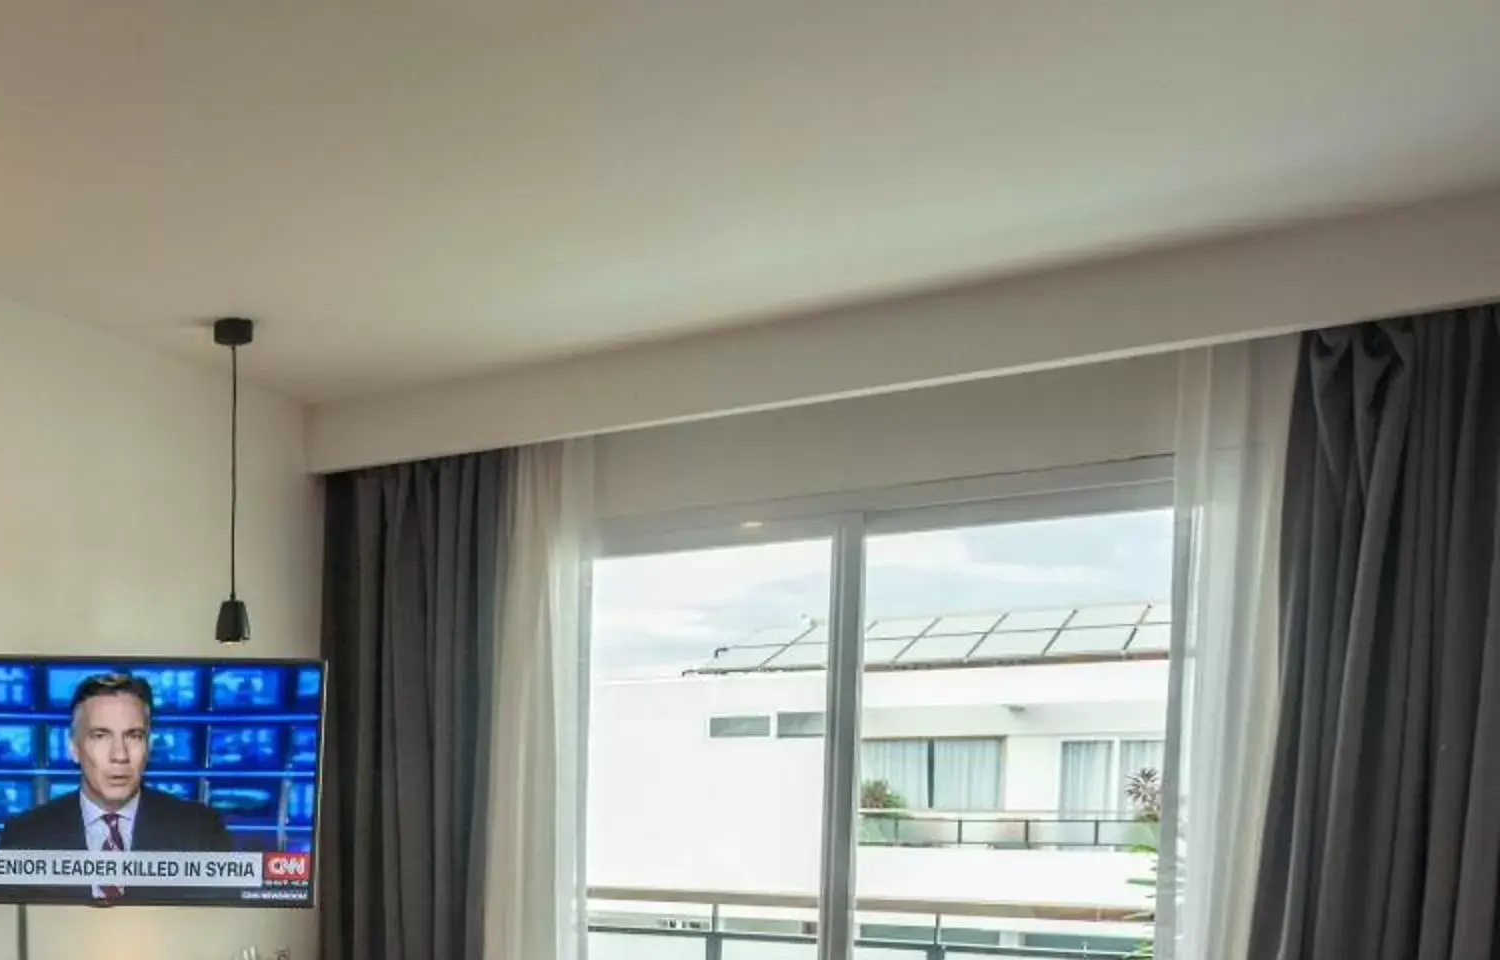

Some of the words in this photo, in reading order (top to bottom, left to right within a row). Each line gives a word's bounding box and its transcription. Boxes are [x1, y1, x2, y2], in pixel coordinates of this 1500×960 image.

[52, 860, 117, 876] LEADER
[122, 860, 179, 877] KILLED
[184, 861, 201, 877] IN
[205, 861, 255, 877] SYRIA
[268, 858, 305, 875] CNN
